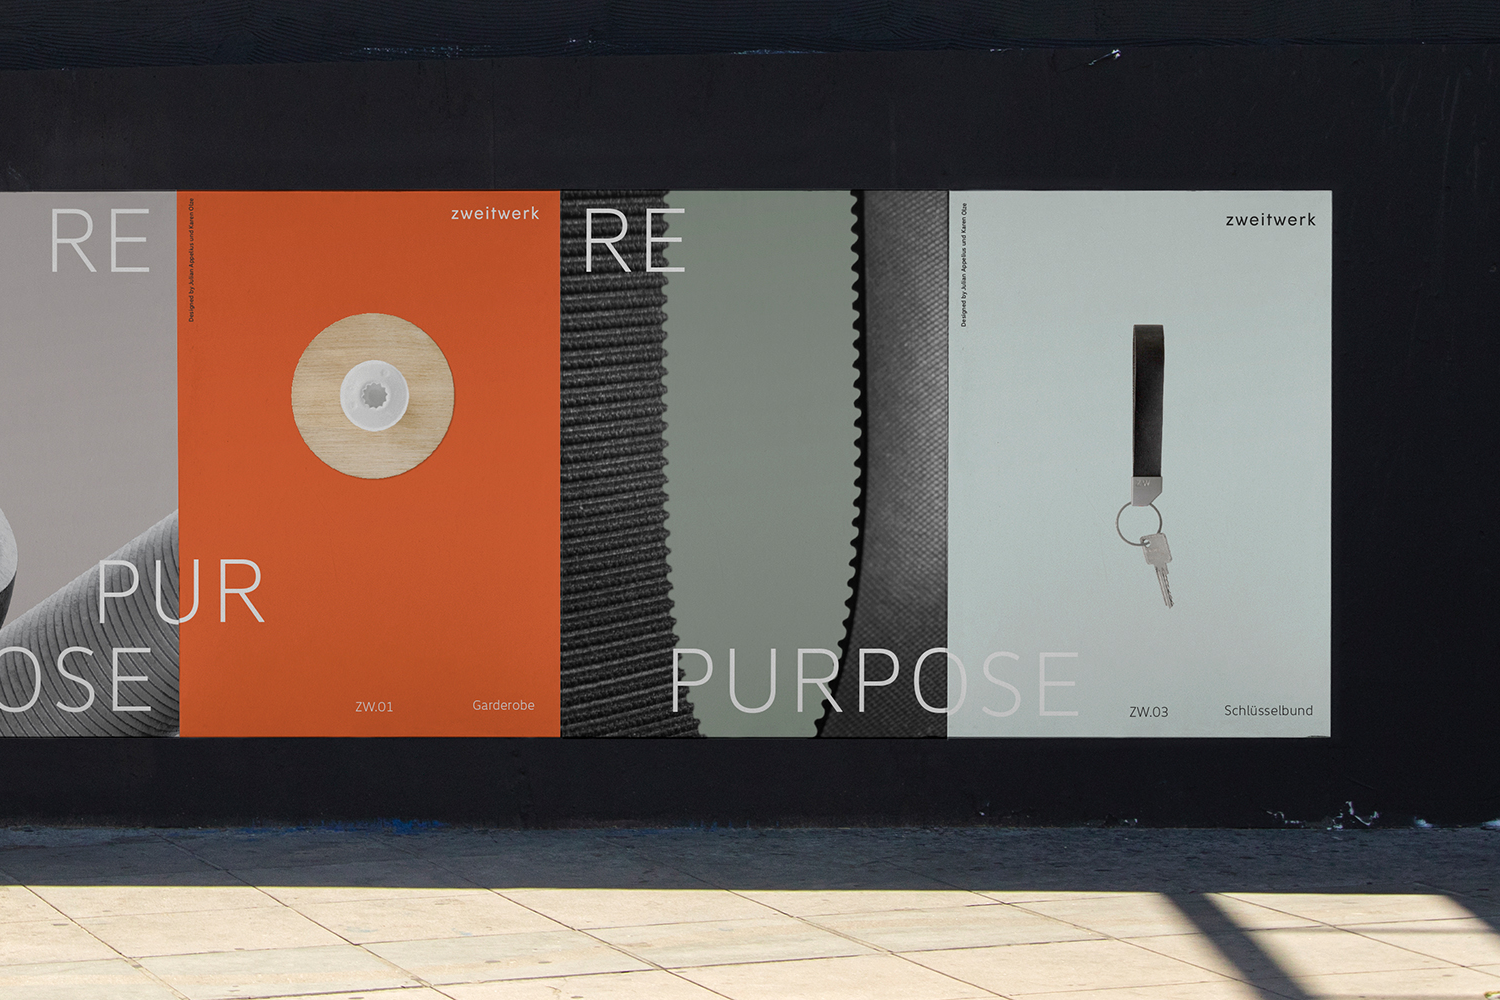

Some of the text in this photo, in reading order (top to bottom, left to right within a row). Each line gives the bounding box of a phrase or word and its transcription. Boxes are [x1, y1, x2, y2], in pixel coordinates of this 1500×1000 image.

[451, 206, 540, 220] zweitwerk
[1225, 212, 1317, 227] zweitwerk
[51, 207, 150, 273] RE
[585, 207, 685, 273] RE
[100, 559, 265, 624] PUR
[672, 647, 1080, 717] PURPOSE
[355, 701, 394, 713] ZW.01
[472, 698, 536, 712] Garderobe
[1129, 705, 1169, 719] ZW.03
[1224, 702, 1314, 717] Schlüsselbund
